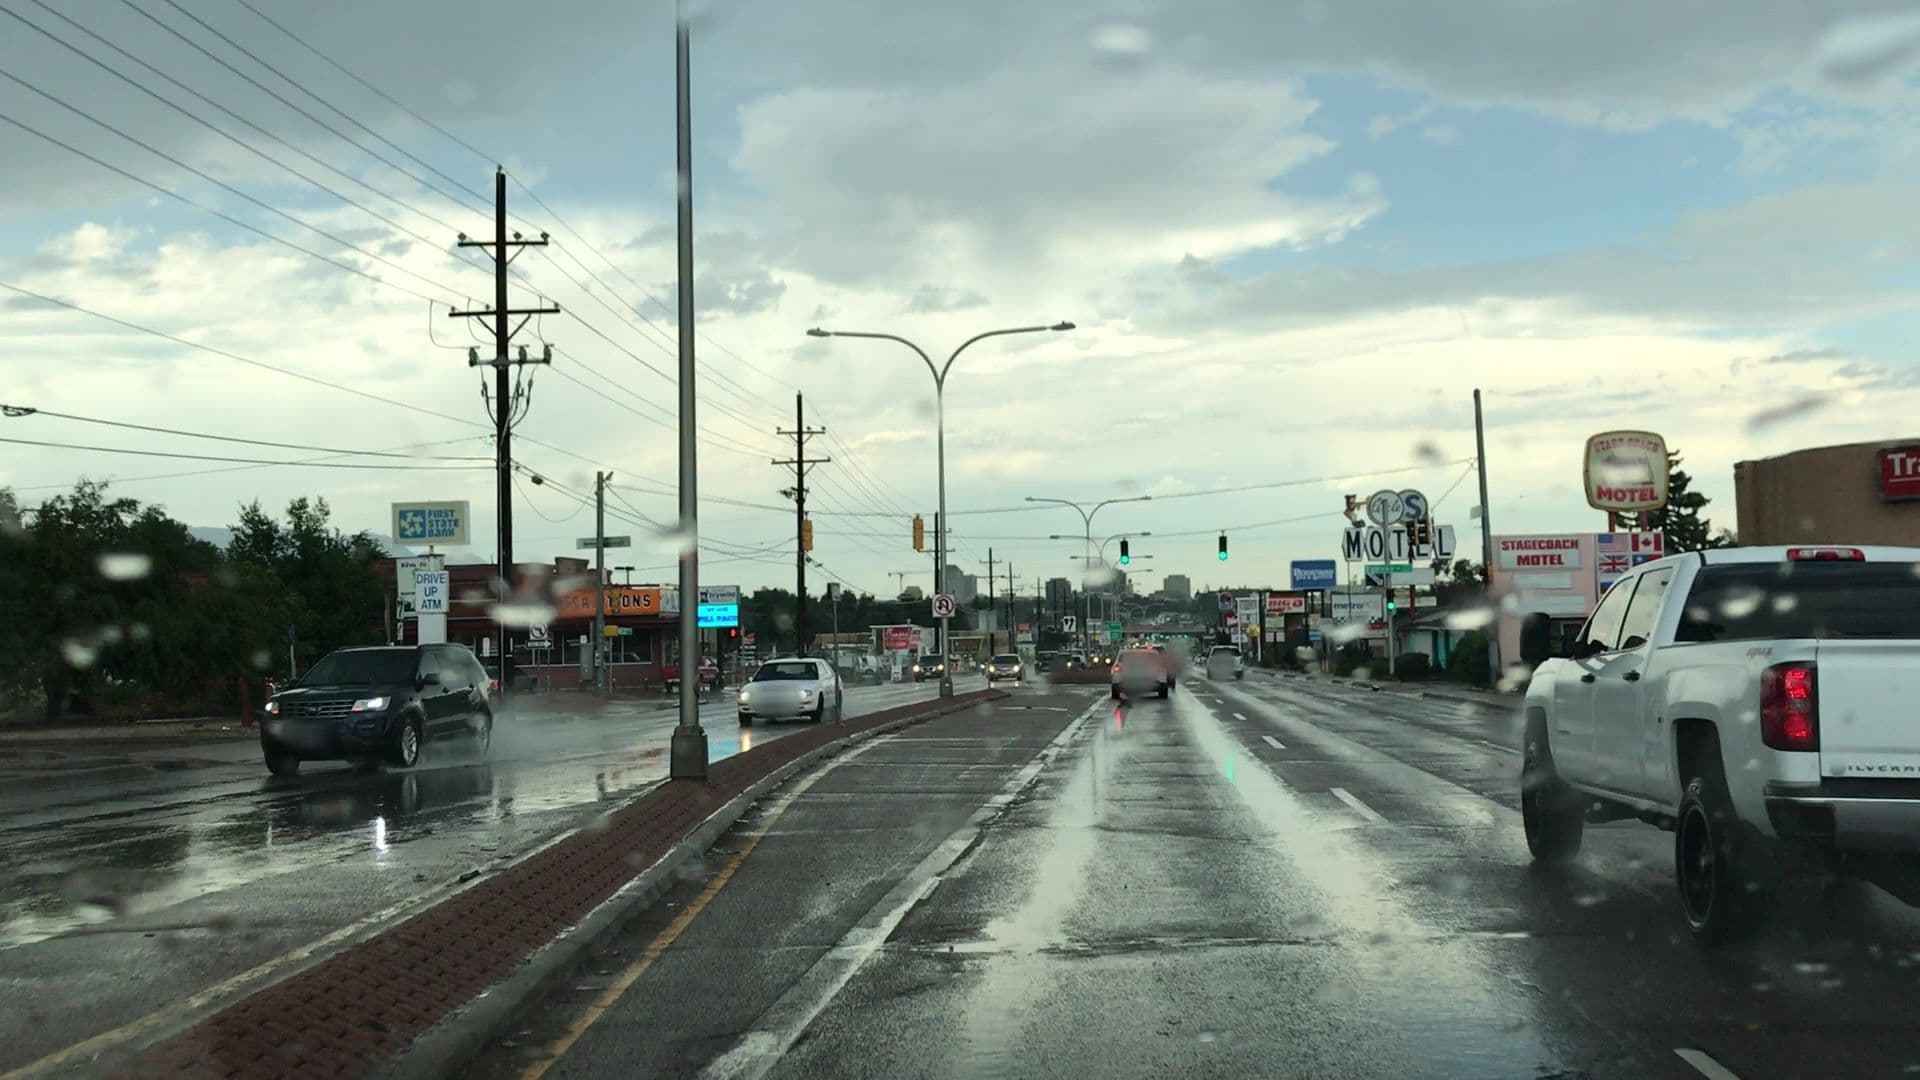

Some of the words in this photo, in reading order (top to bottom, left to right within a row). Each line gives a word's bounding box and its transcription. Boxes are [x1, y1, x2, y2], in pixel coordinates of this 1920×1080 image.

[1887, 452, 1920, 476] Tr
[1597, 485, 1659, 502] MOTEL
[1346, 527, 1452, 559] MOTEL
[1501, 539, 1579, 551] STAGECOACH
[1516, 554, 1565, 566] MOTEL
[416, 573, 447, 585] DRIVE
[424, 586, 439, 598] UP
[421, 599, 442, 610] ATM
[1833, 764, 1920, 773] ILVERA
